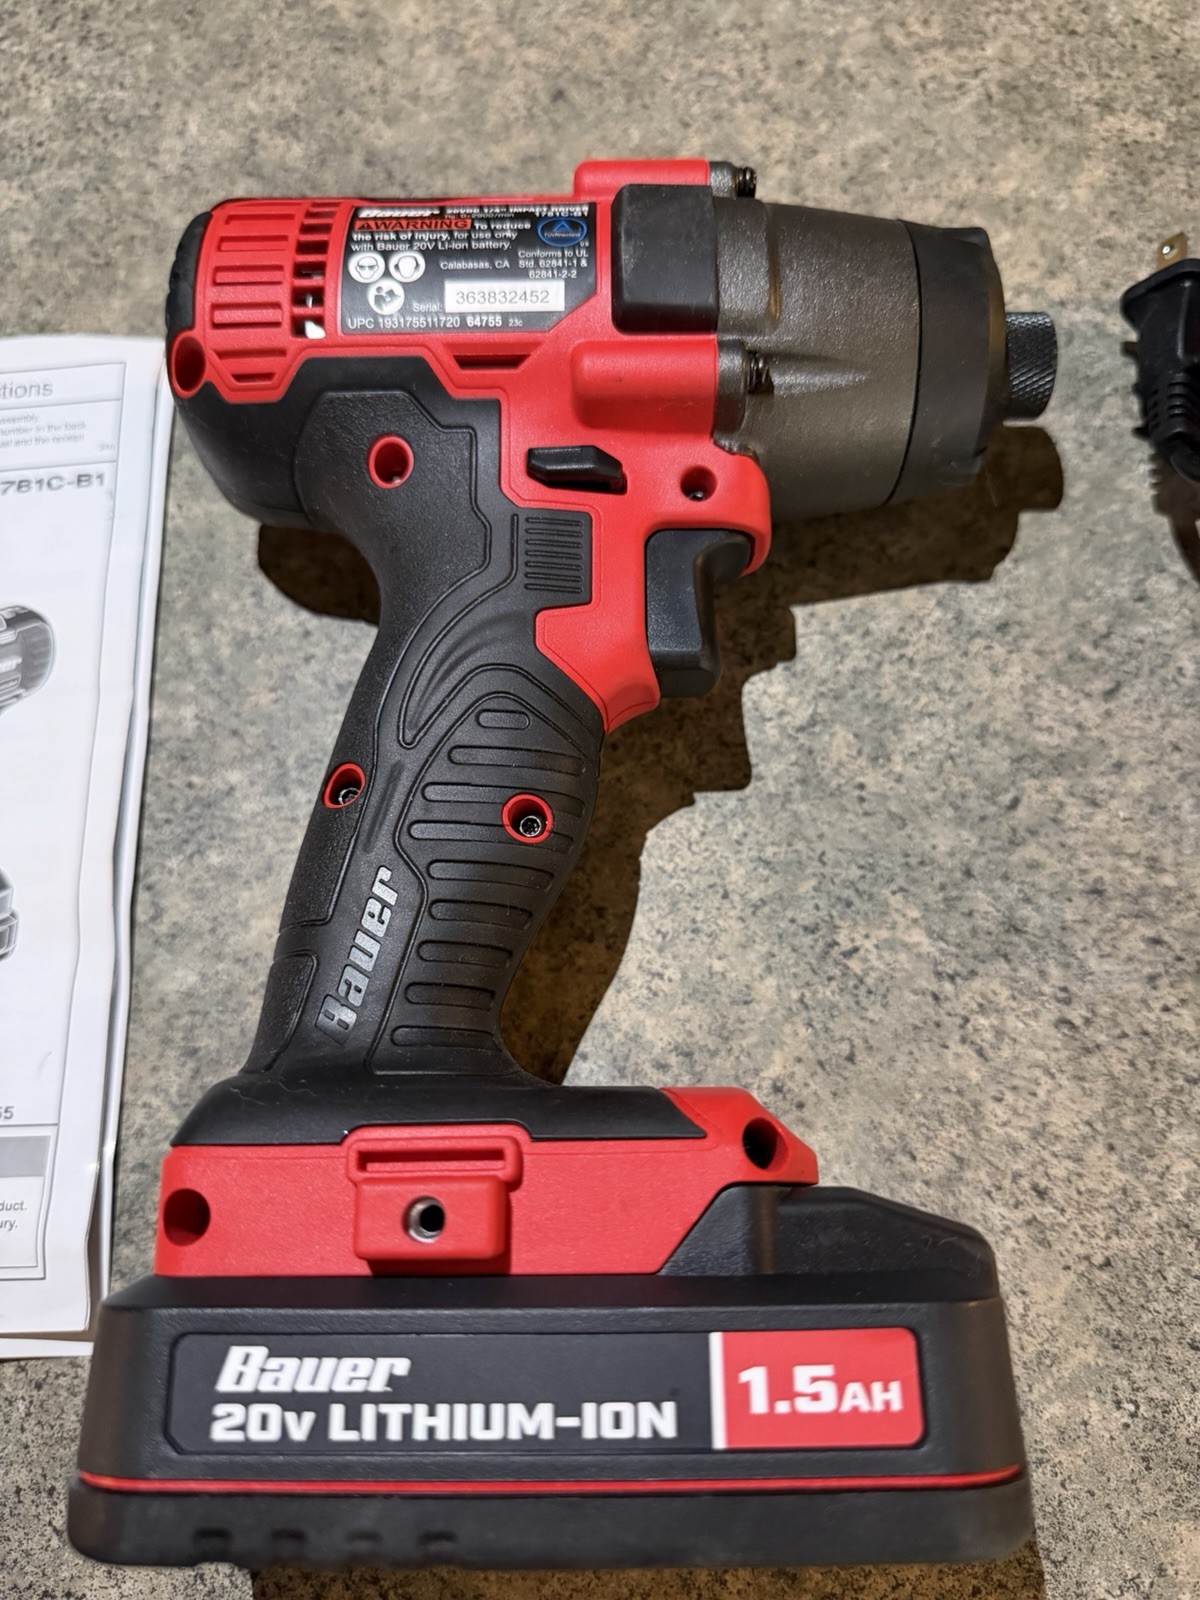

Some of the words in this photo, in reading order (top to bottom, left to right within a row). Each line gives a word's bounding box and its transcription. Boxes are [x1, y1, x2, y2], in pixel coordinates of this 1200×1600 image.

[372, 220, 468, 230] WARNING
[474, 221, 488, 230] To
[491, 219, 531, 230] reduce
[353, 232, 371, 241] the
[375, 231, 397, 241] risk
[400, 231, 412, 240] of
[415, 231, 450, 242] injury,
[454, 230, 468, 239] for
[472, 231, 491, 239] use
[495, 230, 518, 240] only
[351, 242, 374, 251] with
[377, 242, 410, 251] Bauer
[414, 241, 435, 250] 20V
[438, 241, 469, 250] Li-ion
[472, 240, 512, 251] battery.
[518, 248, 561, 258] Conforms
[564, 249, 573, 257] to
[575, 248, 589, 257] UL
[440, 260, 492, 270] Calabasas,
[495, 260, 510, 268] CA
[518, 259, 537, 268] Std.
[539, 259, 577, 268] 62841-1
[580, 260, 588, 268] &
[529, 270, 577, 279] 62841-2-2
[412, 303, 443, 312] Serial:
[456, 290, 550, 305] 363832452
[348, 318, 375, 329] UPC
[379, 316, 460, 328] 193175511720
[466, 316, 502, 327] 64755
[0, 382, 53, 399] tions
[315, 865, 398, 1046] Bauer
[0, 1105, 15, 1120] 5
[216, 1345, 411, 1393] Bauer
[738, 1364, 904, 1415] 1.5AH
[328, 1401, 677, 1442] LITHIUM-ION
